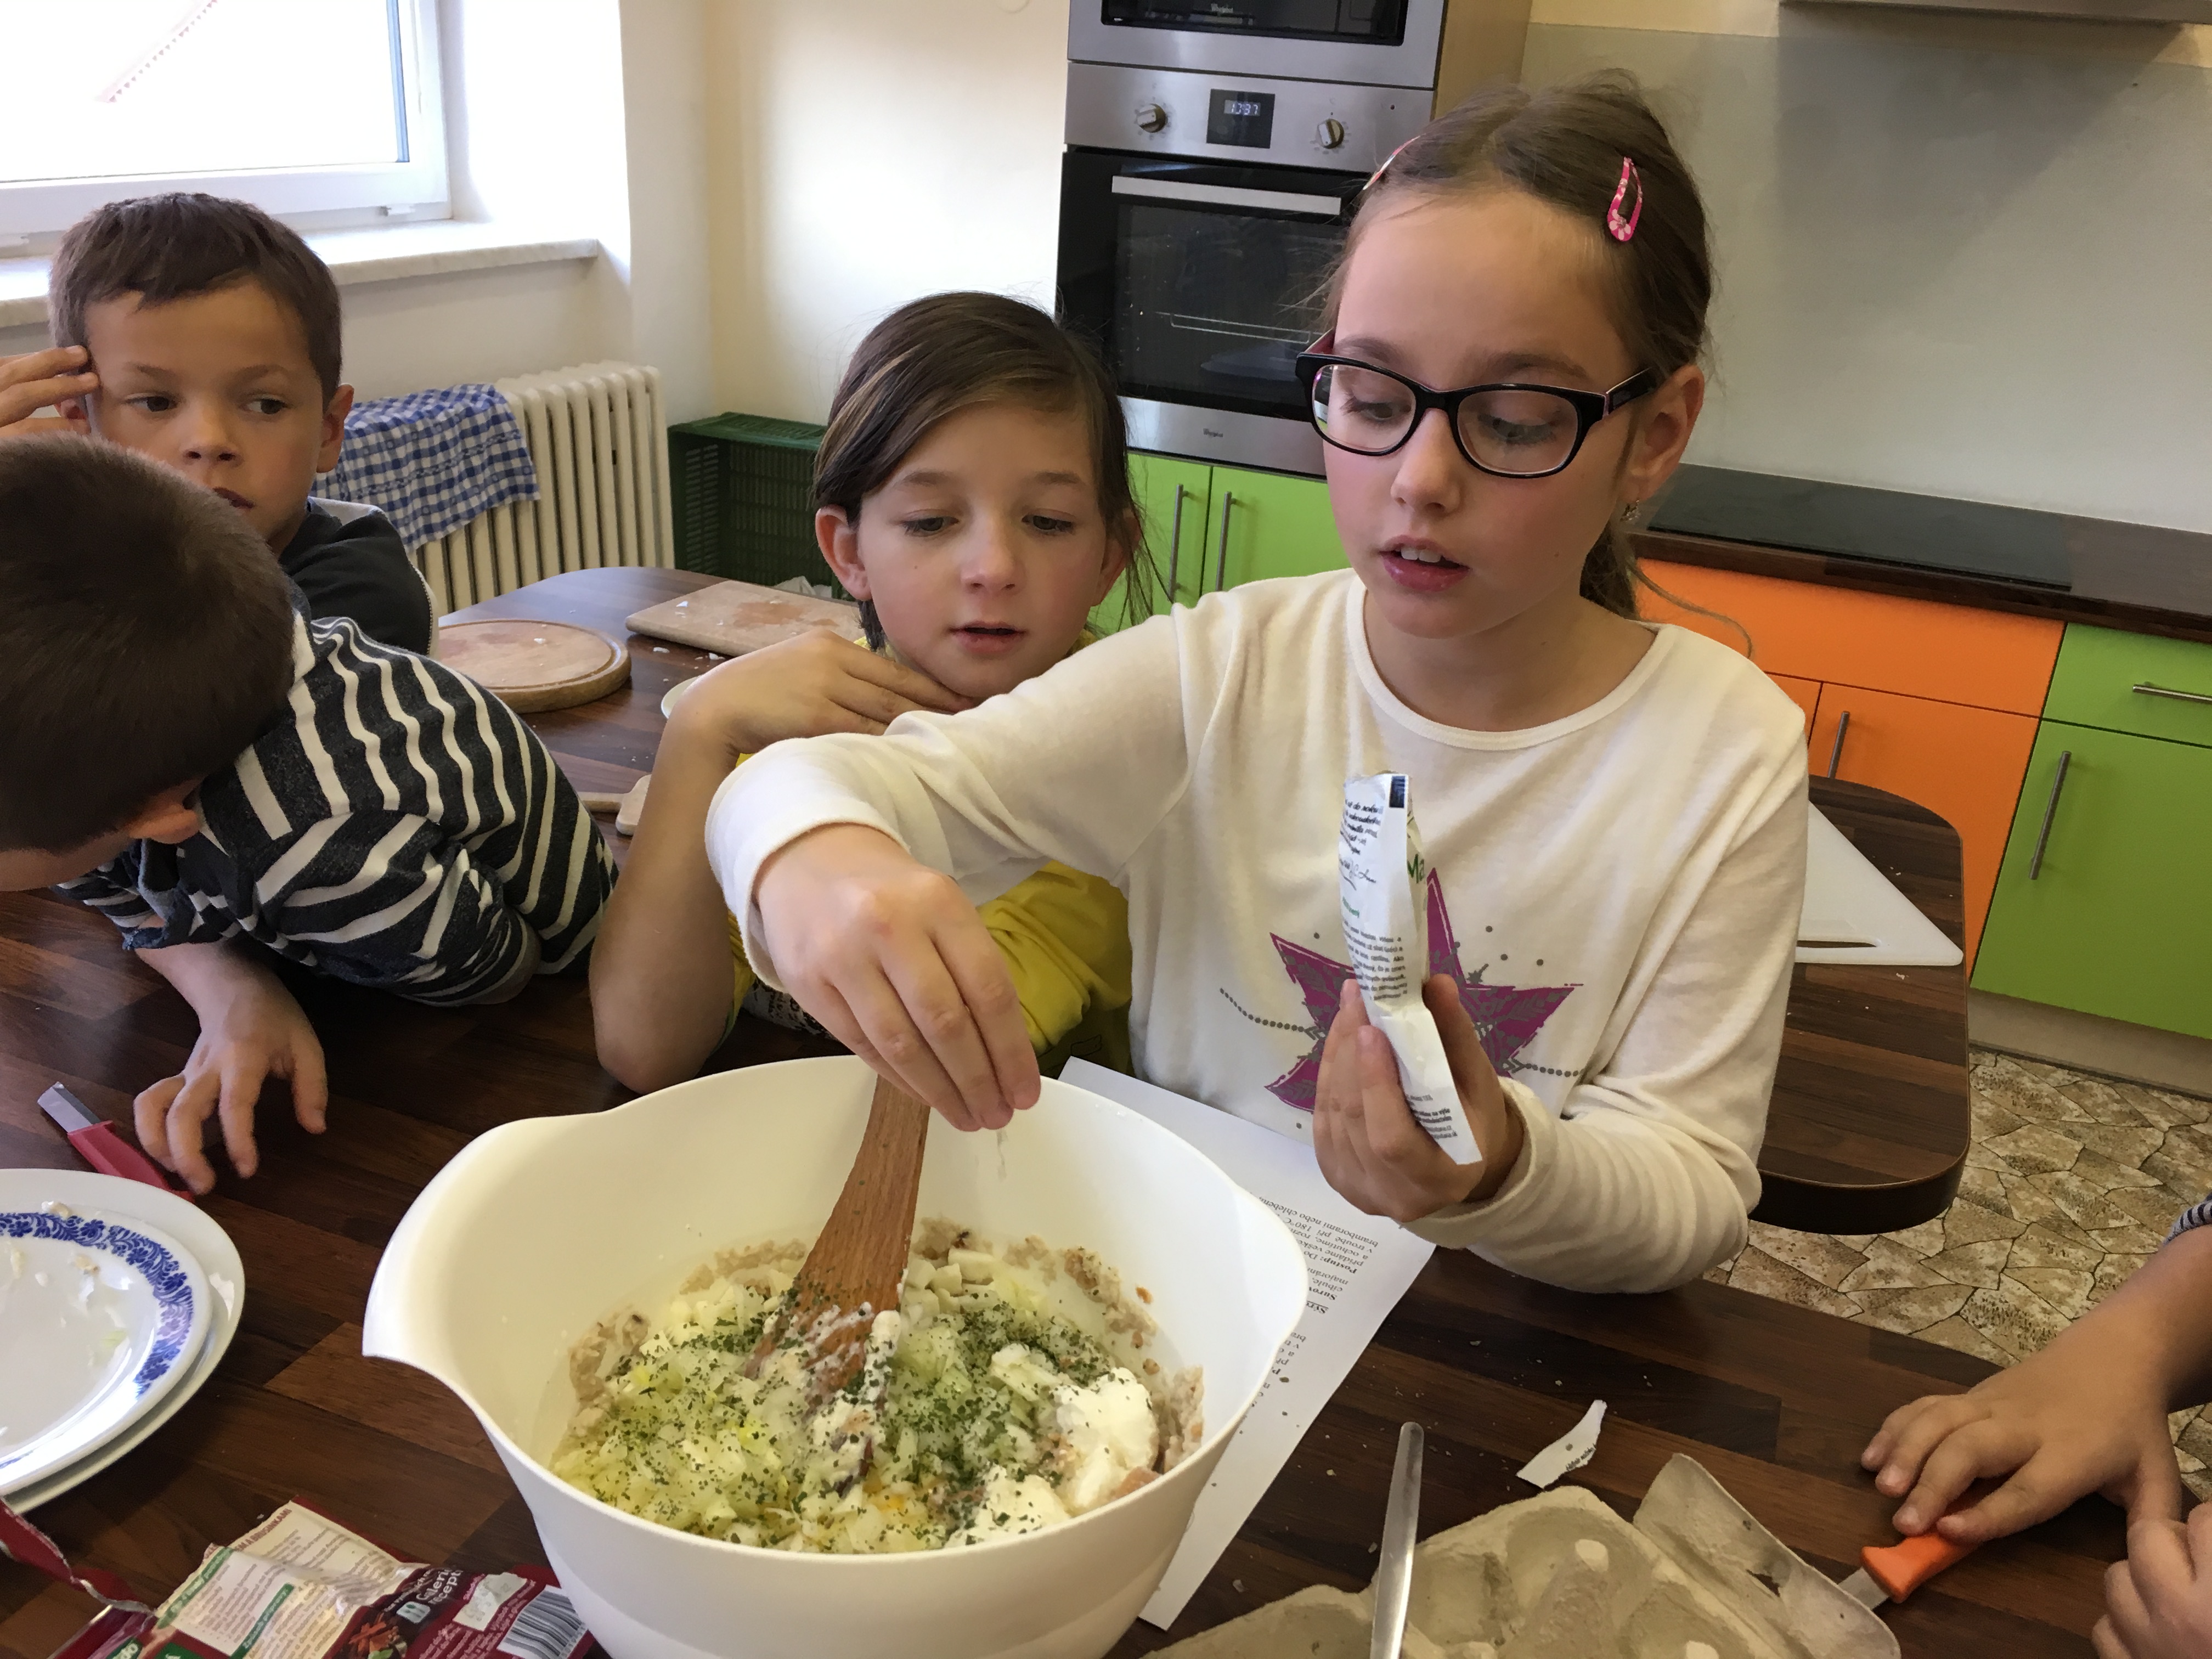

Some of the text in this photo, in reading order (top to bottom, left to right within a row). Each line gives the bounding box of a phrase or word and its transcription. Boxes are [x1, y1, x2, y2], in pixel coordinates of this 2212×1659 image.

[1283, 1217, 1312, 1232] 180°C
[1299, 1213, 1322, 1225] nebo
[1317, 1229, 1332, 1238] při
[1323, 1222, 1379, 1248] bramborami
[1315, 1237, 1359, 1257] ochutíme,
[1335, 1236, 1365, 1251] troubě
[1304, 1250, 1358, 1274] Postup: Do
[1324, 1250, 1365, 1267] přidáme
[1312, 1277, 1343, 1293] cibule,
